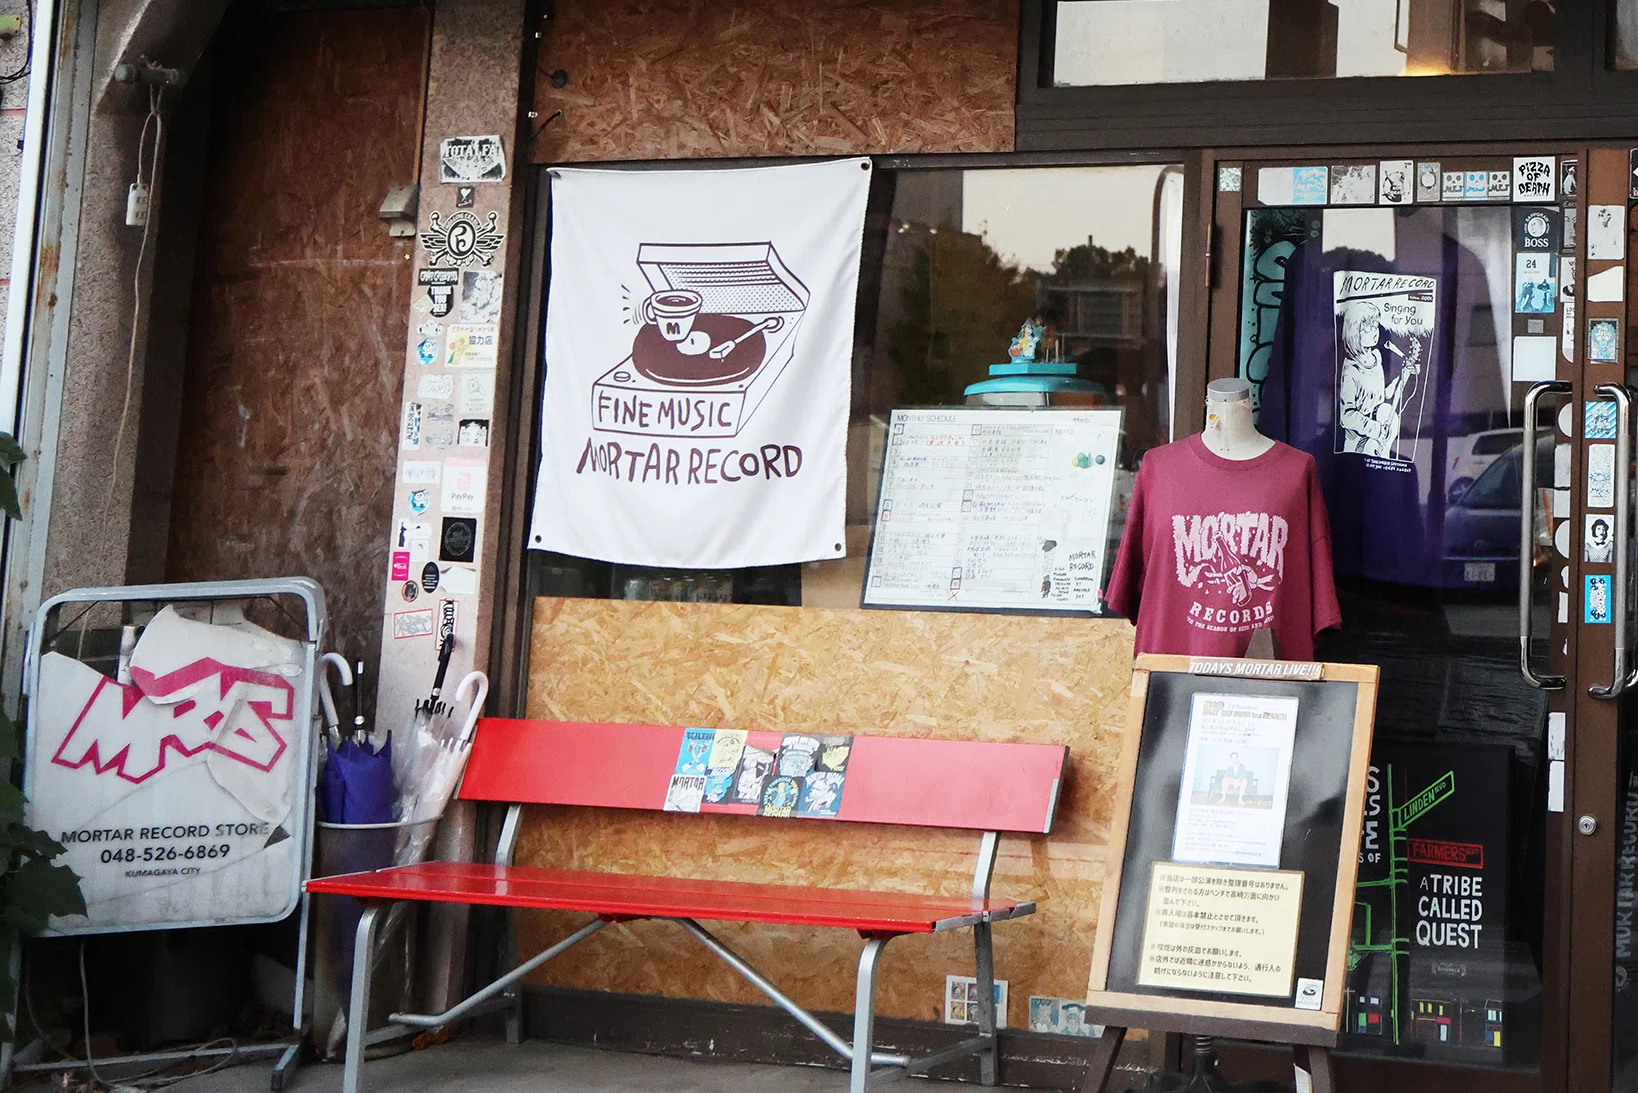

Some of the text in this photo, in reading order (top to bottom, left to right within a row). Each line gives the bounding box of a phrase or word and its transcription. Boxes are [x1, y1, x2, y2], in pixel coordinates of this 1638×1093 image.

[1527, 173, 1539, 181] OF
[1518, 183, 1551, 196] DEATH
[1524, 238, 1549, 248] BOSS
[1526, 260, 1537, 268] 24
[1340, 276, 1435, 295] MORTAR RECORD
[1384, 303, 1416, 315] Singing
[1391, 315, 1423, 325] for You
[597, 389, 732, 431] FINE MUSIC
[576, 437, 803, 485] MORTAR RECORD
[1069, 550, 1096, 561] MORTAR
[1172, 511, 1289, 588] MORTAR
[1189, 600, 1273, 624] RECORDS
[1188, 661, 1233, 674] TODAYS
[1234, 663, 1283, 676] MORTAR
[1403, 788, 1435, 821] LINDEN
[61, 822, 269, 843] MORTAR RECORD STORE
[100, 844, 231, 864] 048-526-6869
[1368, 852, 1381, 864] OF
[1412, 842, 1467, 861] FARMERS
[125, 867, 201, 878] KUMAGAYA CITY
[1420, 873, 1483, 896] A TRIBE
[1418, 895, 1483, 922] CALLED
[1416, 920, 1483, 949] QUEST
